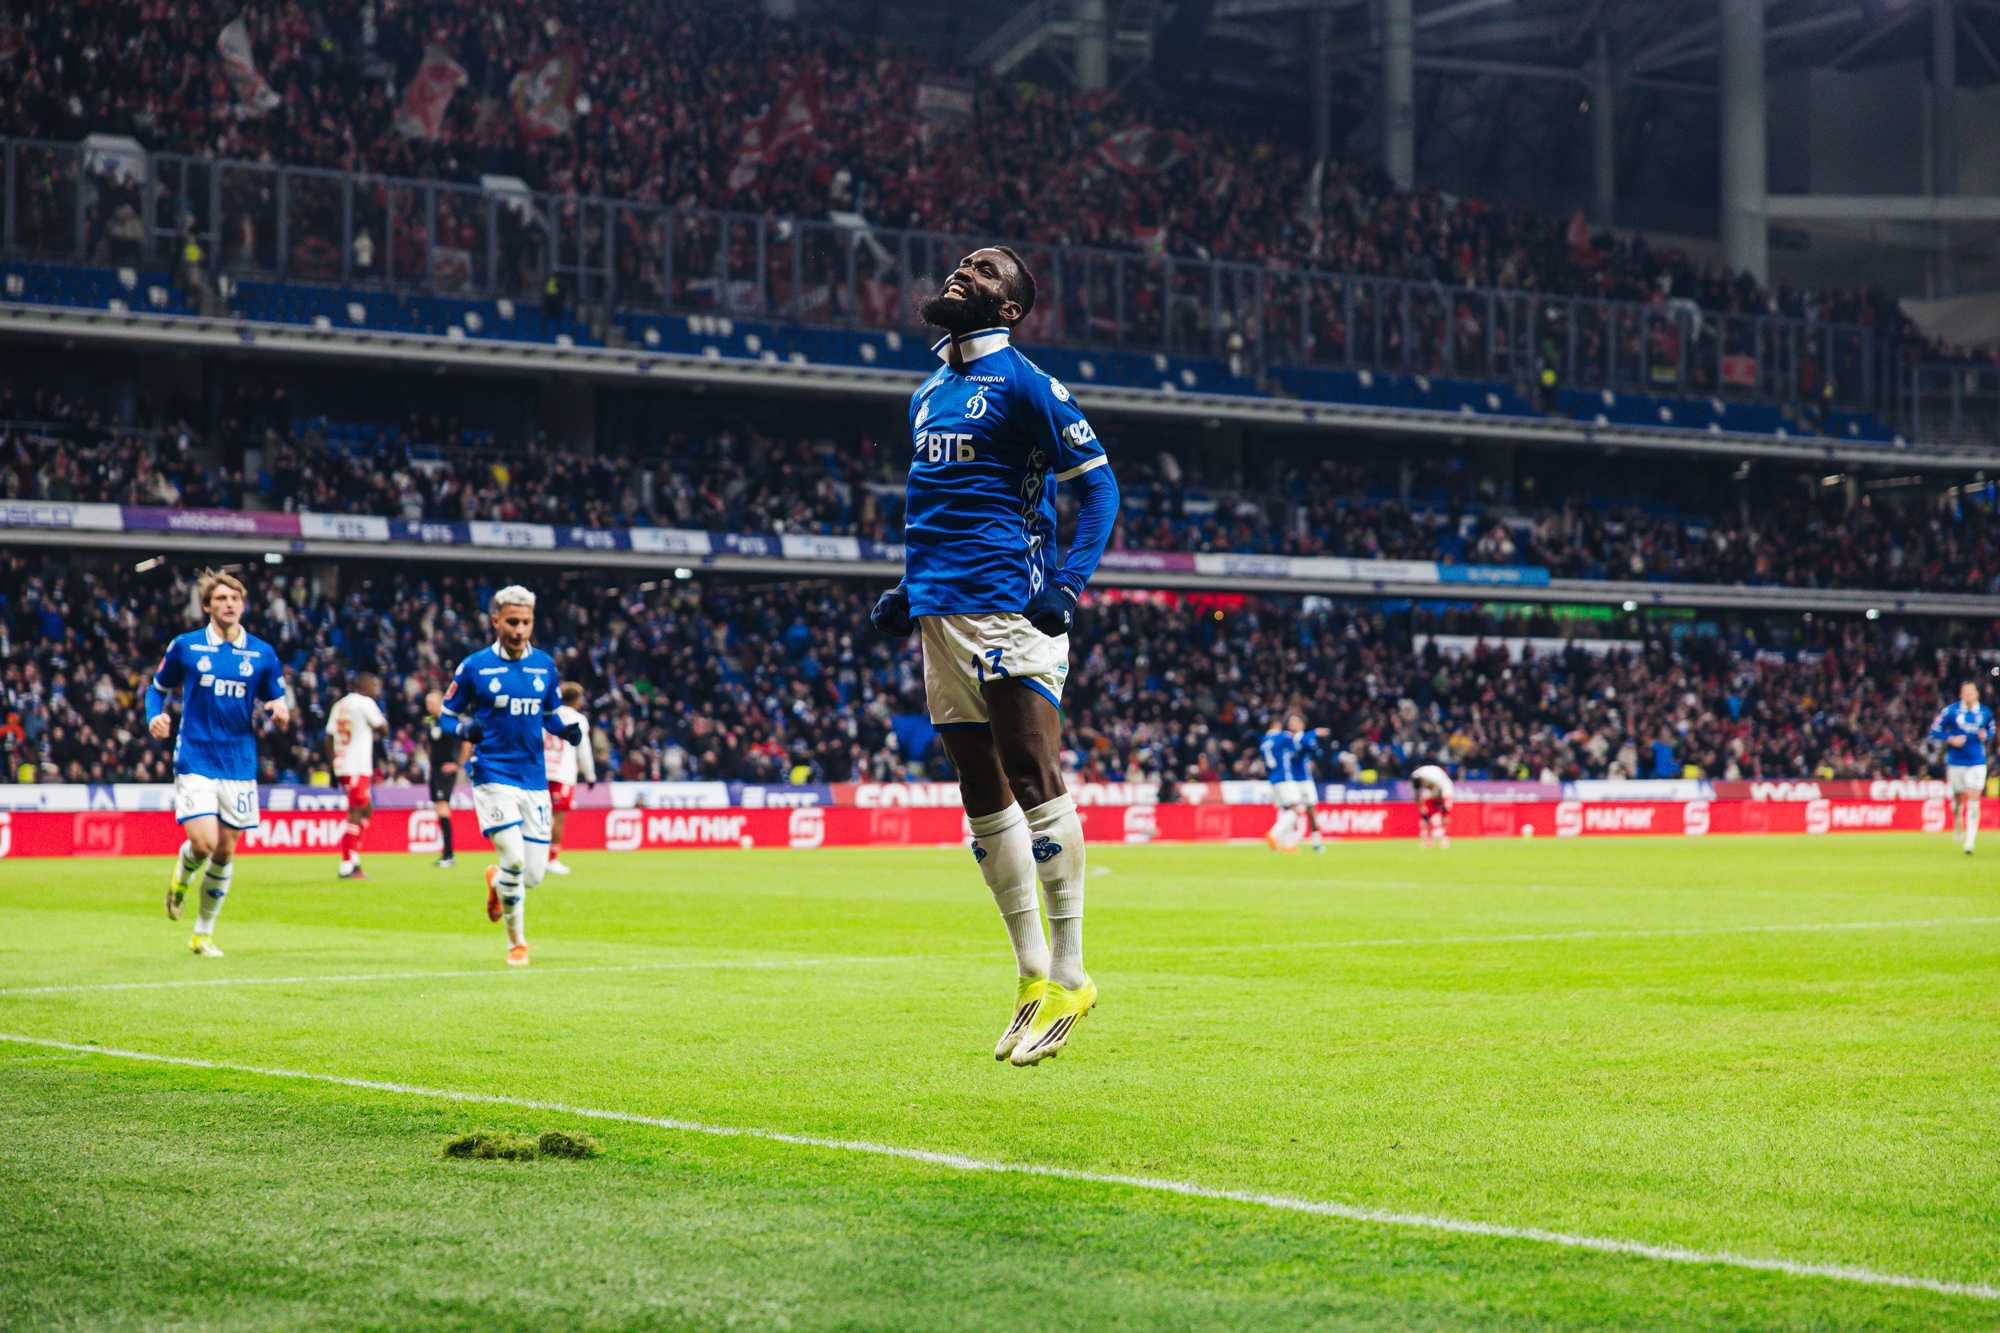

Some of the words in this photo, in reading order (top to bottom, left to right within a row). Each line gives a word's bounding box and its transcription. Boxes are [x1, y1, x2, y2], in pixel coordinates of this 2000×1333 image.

[965, 375, 1006, 383] CHANGAN
[928, 433, 976, 463] ВТБ
[214, 678, 247, 698] ВТБ
[510, 697, 542, 716] ВТБ
